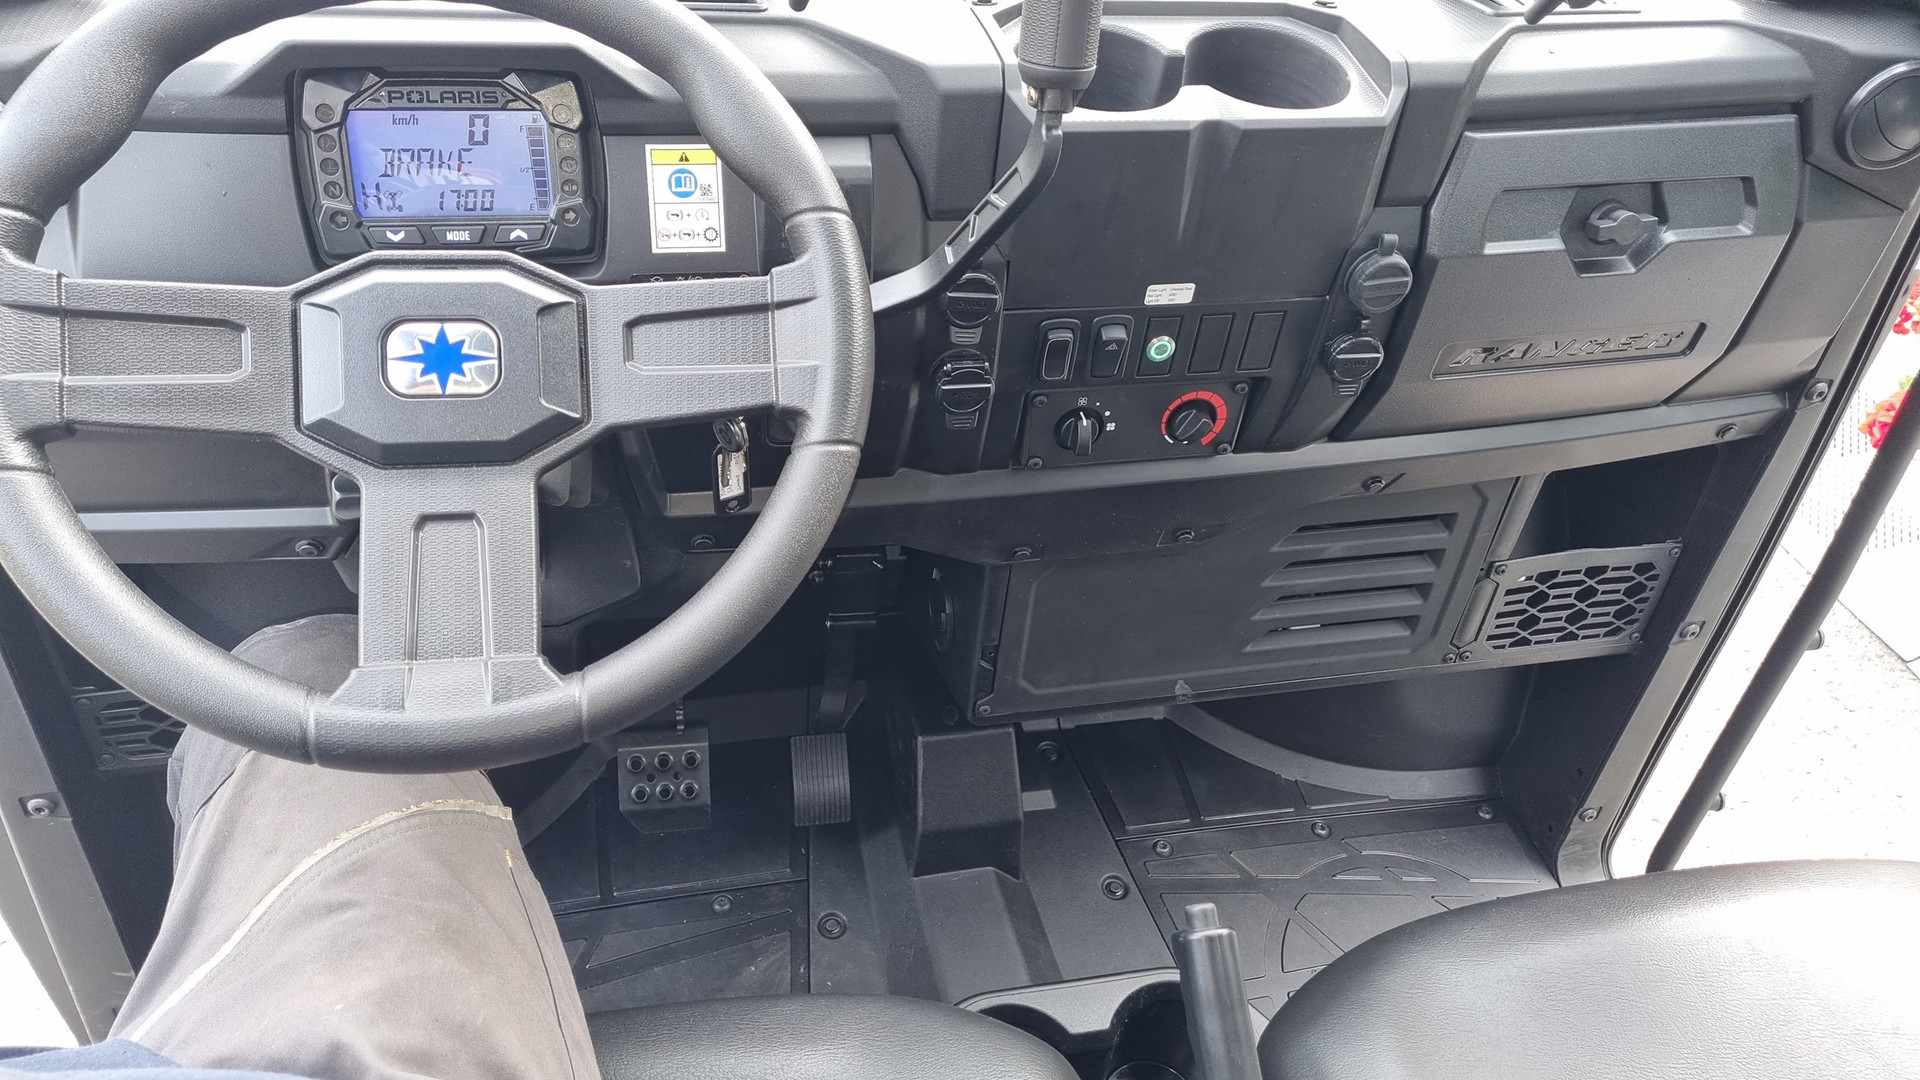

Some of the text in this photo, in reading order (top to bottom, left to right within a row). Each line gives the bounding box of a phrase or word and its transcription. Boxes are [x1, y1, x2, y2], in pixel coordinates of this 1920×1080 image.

[387, 90, 499, 104] POLARIS
[391, 114, 419, 127] km/h
[468, 113, 490, 146] 0
[378, 148, 475, 178] BRAKE
[439, 189, 495, 211] 17:00
[446, 230, 471, 241] MODE
[1449, 330, 1684, 367] RANGER
